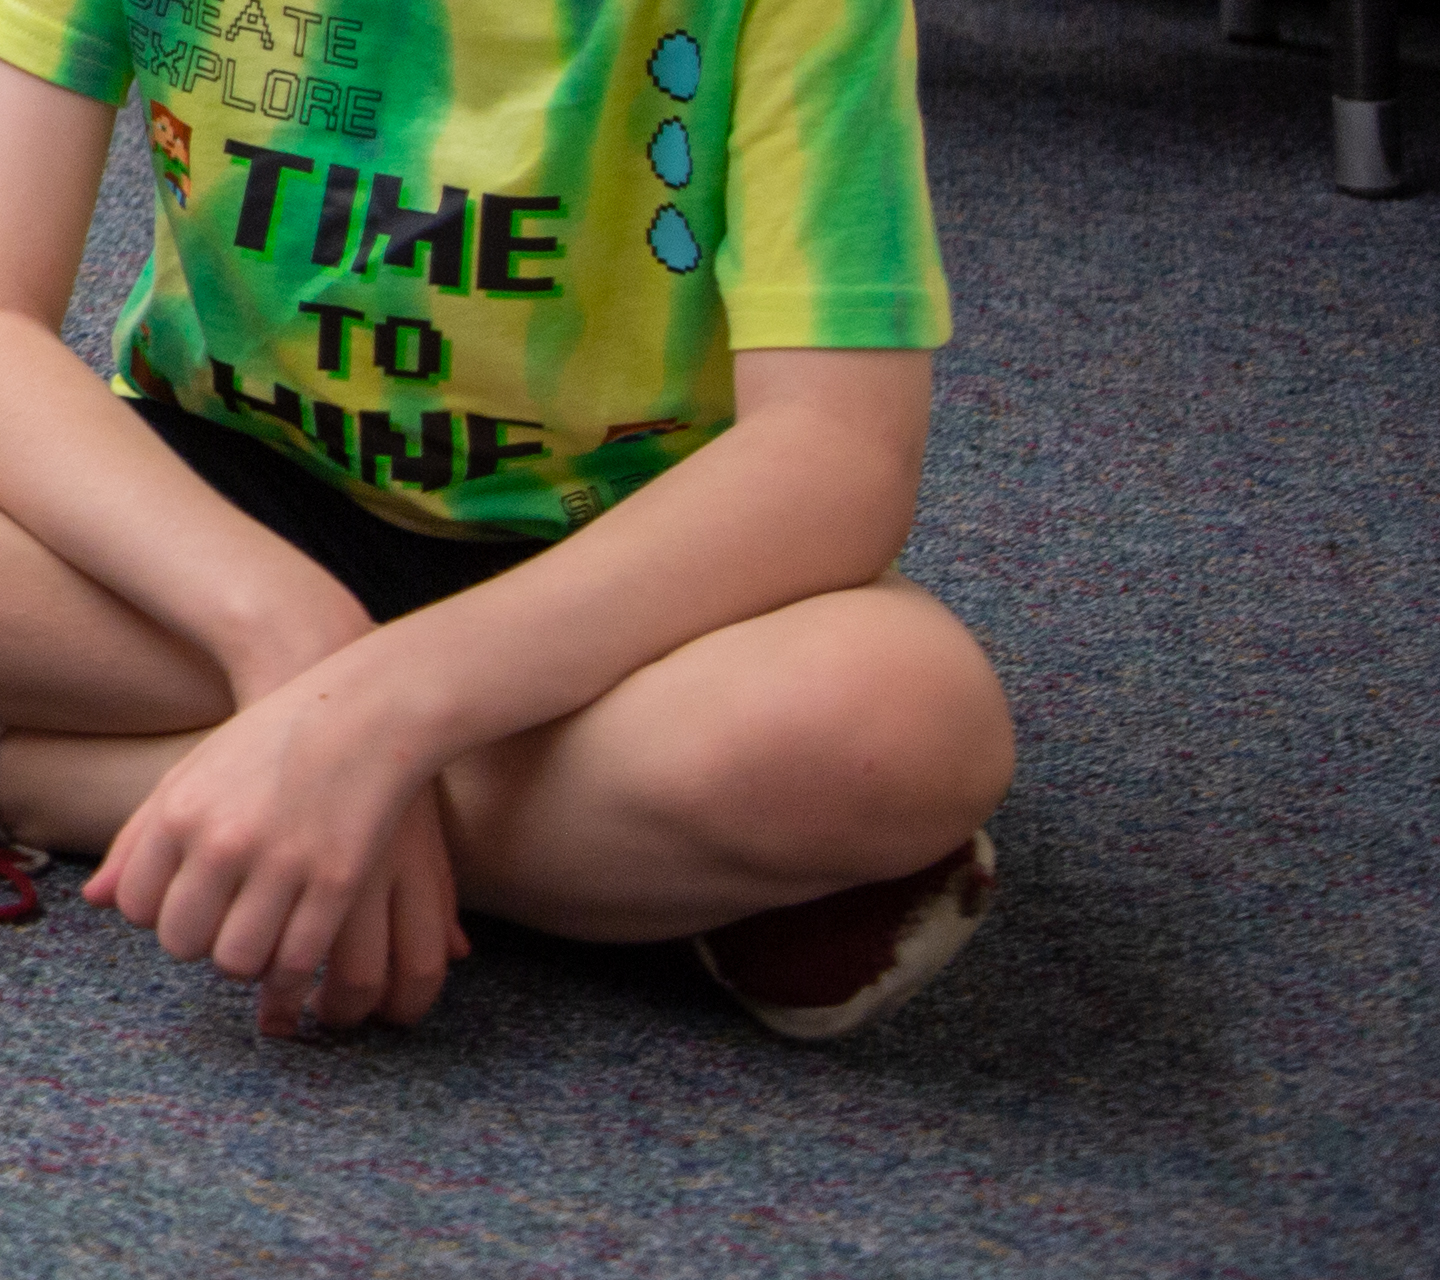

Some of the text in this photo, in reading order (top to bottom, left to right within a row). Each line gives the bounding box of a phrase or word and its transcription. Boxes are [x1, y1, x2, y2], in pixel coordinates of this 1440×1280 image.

[125, 15, 383, 140] EXPLORE
[223, 138, 568, 297] TIME
[297, 299, 452, 385] TO
